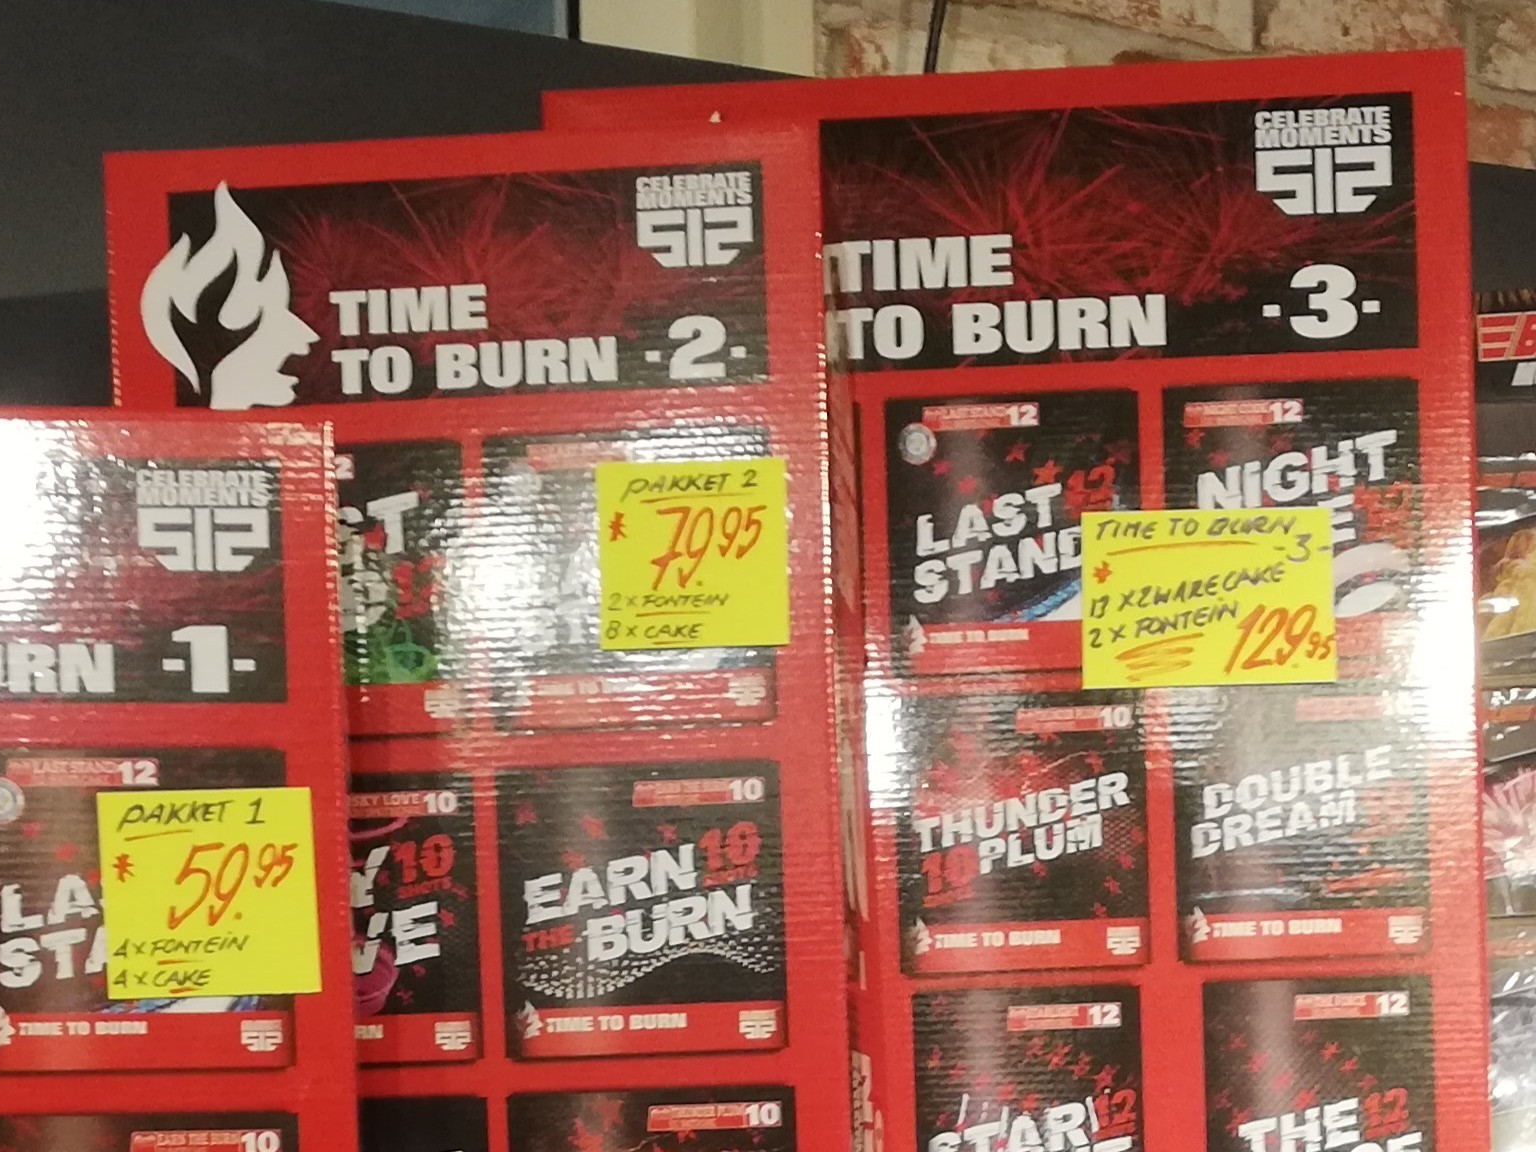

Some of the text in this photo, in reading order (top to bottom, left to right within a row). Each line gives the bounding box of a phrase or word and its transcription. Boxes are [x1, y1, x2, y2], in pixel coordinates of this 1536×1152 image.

[1254, 106, 1392, 130] CELEBRATE
[1255, 125, 1392, 148] MOMENTS
[635, 172, 751, 195] CELEBRATE
[635, 188, 753, 209] MOMENTS
[839, 233, 1014, 293] TIME
[328, 284, 488, 336] TIME
[839, 295, 1167, 361] TO BURN
[331, 336, 618, 394] TO BURN
[135, 468, 270, 492] CELEBRATE
[1196, 430, 1398, 509] NIGHT
[138, 487, 270, 508] MOMENTS
[621, 470, 759, 503] PAKKET 2
[915, 483, 1063, 558] LAST
[1096, 520, 1157, 540] TIME
[1170, 518, 1199, 535] TO
[644, 622, 704, 640] CAKE
[1088, 629, 1102, 648] 2
[1202, 745, 1396, 821] DOUBLE
[116, 797, 267, 831] PAKKET 1
[1191, 790, 1356, 859] DREAM
